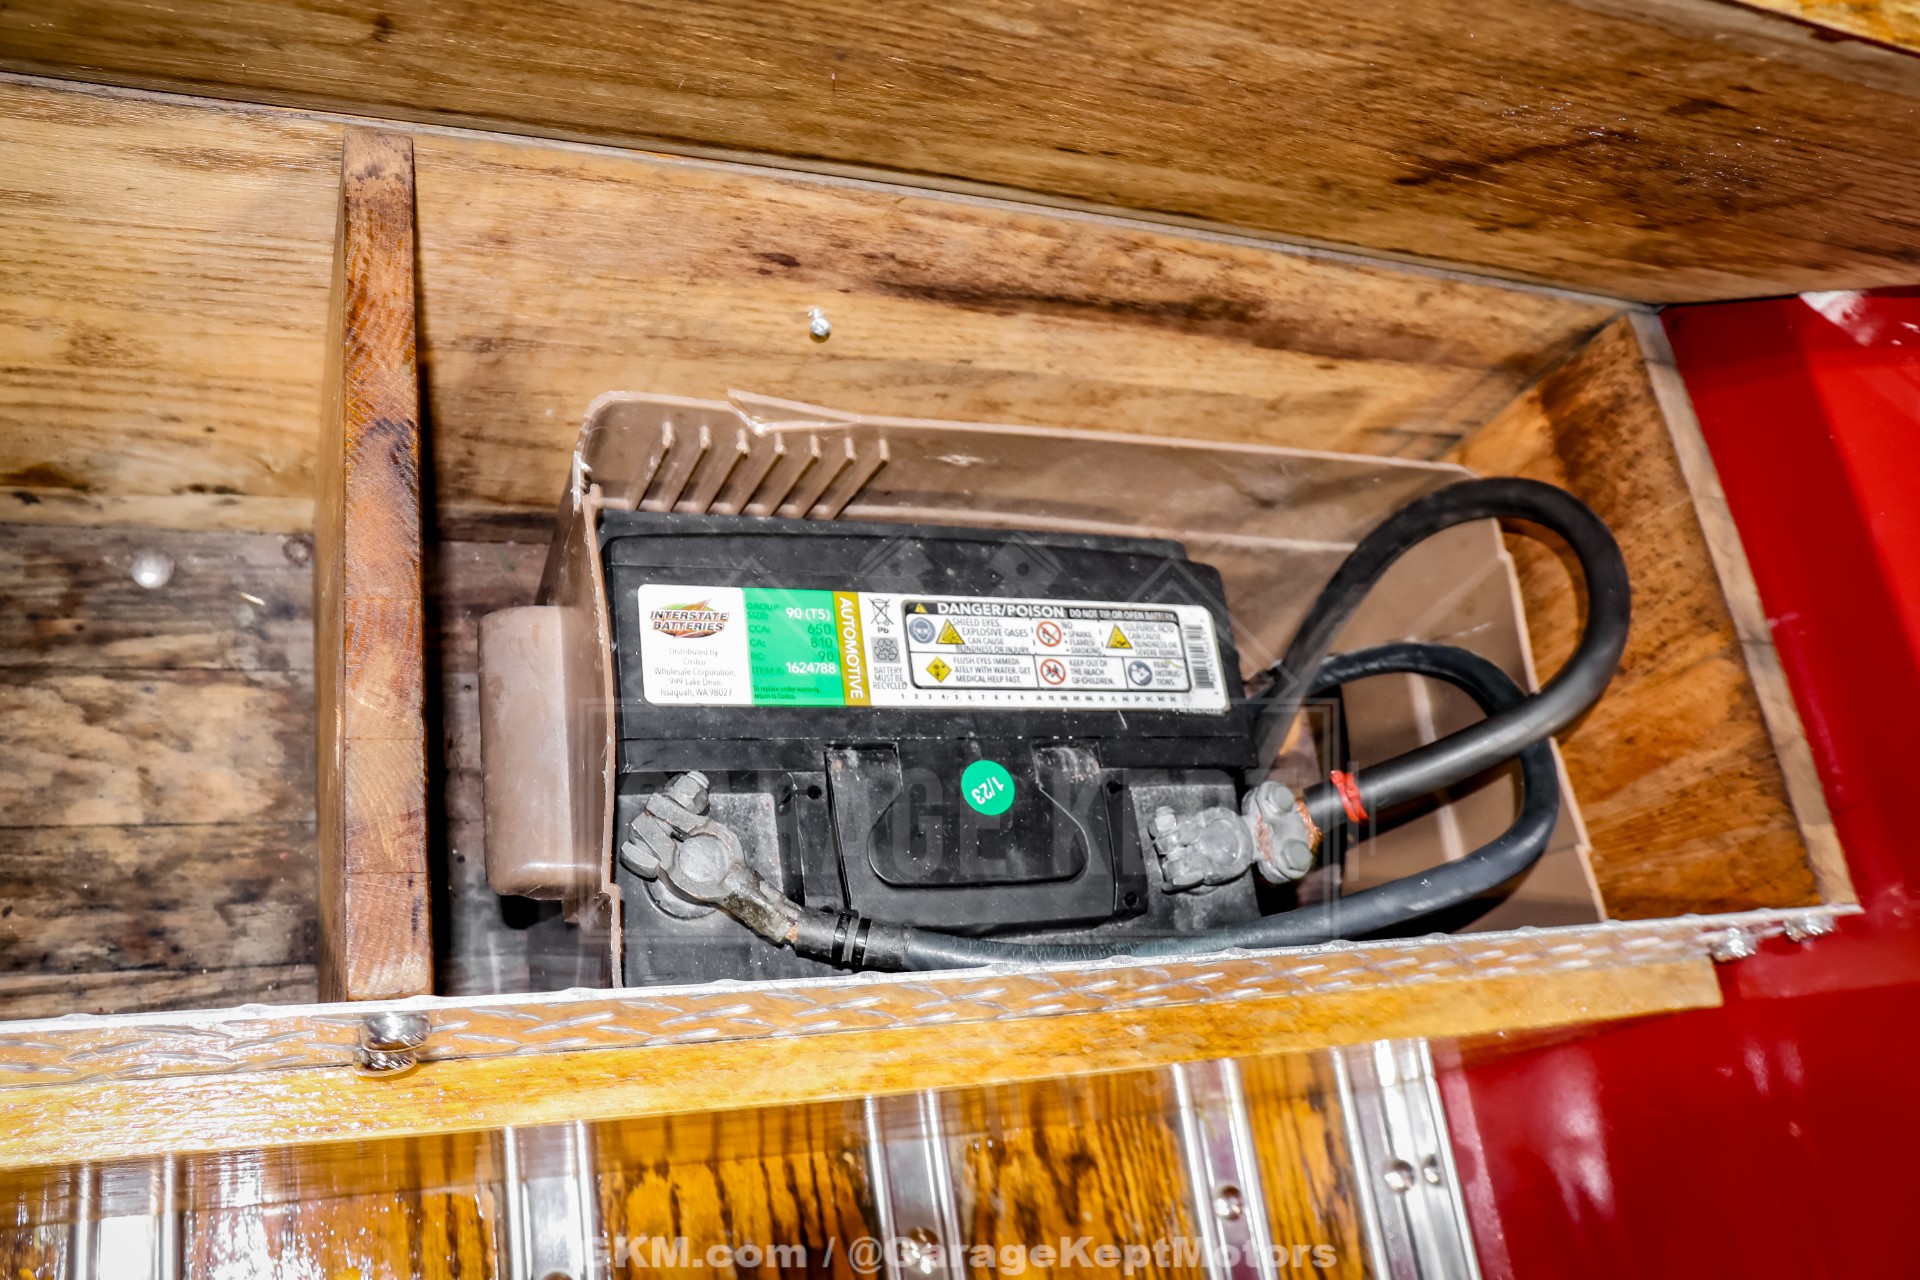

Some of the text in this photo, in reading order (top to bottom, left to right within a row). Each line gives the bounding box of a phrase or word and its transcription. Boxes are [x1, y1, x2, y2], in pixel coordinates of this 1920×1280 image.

[746, 602, 779, 611] GROUP
[937, 602, 1065, 618] DANGER/POISON
[1069, 608, 1081, 618] DO
[1082, 608, 1098, 618] NOT
[1099, 609, 1110, 619] TIP
[1112, 610, 1123, 620] OR
[1124, 610, 1144, 620] OPEN
[650, 610, 729, 621] INTERSTATE
[786, 607, 802, 619] 90
[806, 608, 830, 621] (T5)
[653, 621, 725, 632] BATTERIES
[952, 618, 980, 626] SHIELD
[1062, 622, 1072, 630] NO
[748, 624, 832, 634] CCA: 650
[878, 626, 890, 634] Pb
[962, 628, 1029, 638] EXPLOSIVE GASES
[1122, 624, 1174, 633] SULFURIC ACID
[750, 638, 832, 648] CA: 810
[669, 648, 718, 657] Distributed by
[840, 597, 863, 699] AUTOMOTIVE
[956, 645, 993, 654] BLINDNESS
[994, 646, 1004, 654] OR
[818, 652, 834, 662] 90
[976, 657, 992, 665] EYES
[683, 658, 706, 666] Costco
[654, 667, 736, 677] Wholesale Corporation,
[752, 666, 774, 674] ITEM
[786, 662, 836, 674] 1624788
[874, 666, 902, 674] BATTERY
[954, 666, 973, 674] ATELY
[974, 666, 989, 674] WITH
[1019, 666, 1030, 674] GET
[1070, 668, 1104, 676] THE REACH
[669, 678, 724, 687] 999 Lake Drive,
[874, 674, 904, 682] MUST BE
[956, 675, 986, 683] MEDICAL
[990, 675, 1004, 683] HELP
[760, 686, 778, 694] replace
[872, 682, 907, 690] RECYCLED
[660, 688, 732, 698] Issaquah, WA 98027
[971, 776, 1004, 805] 1/23
